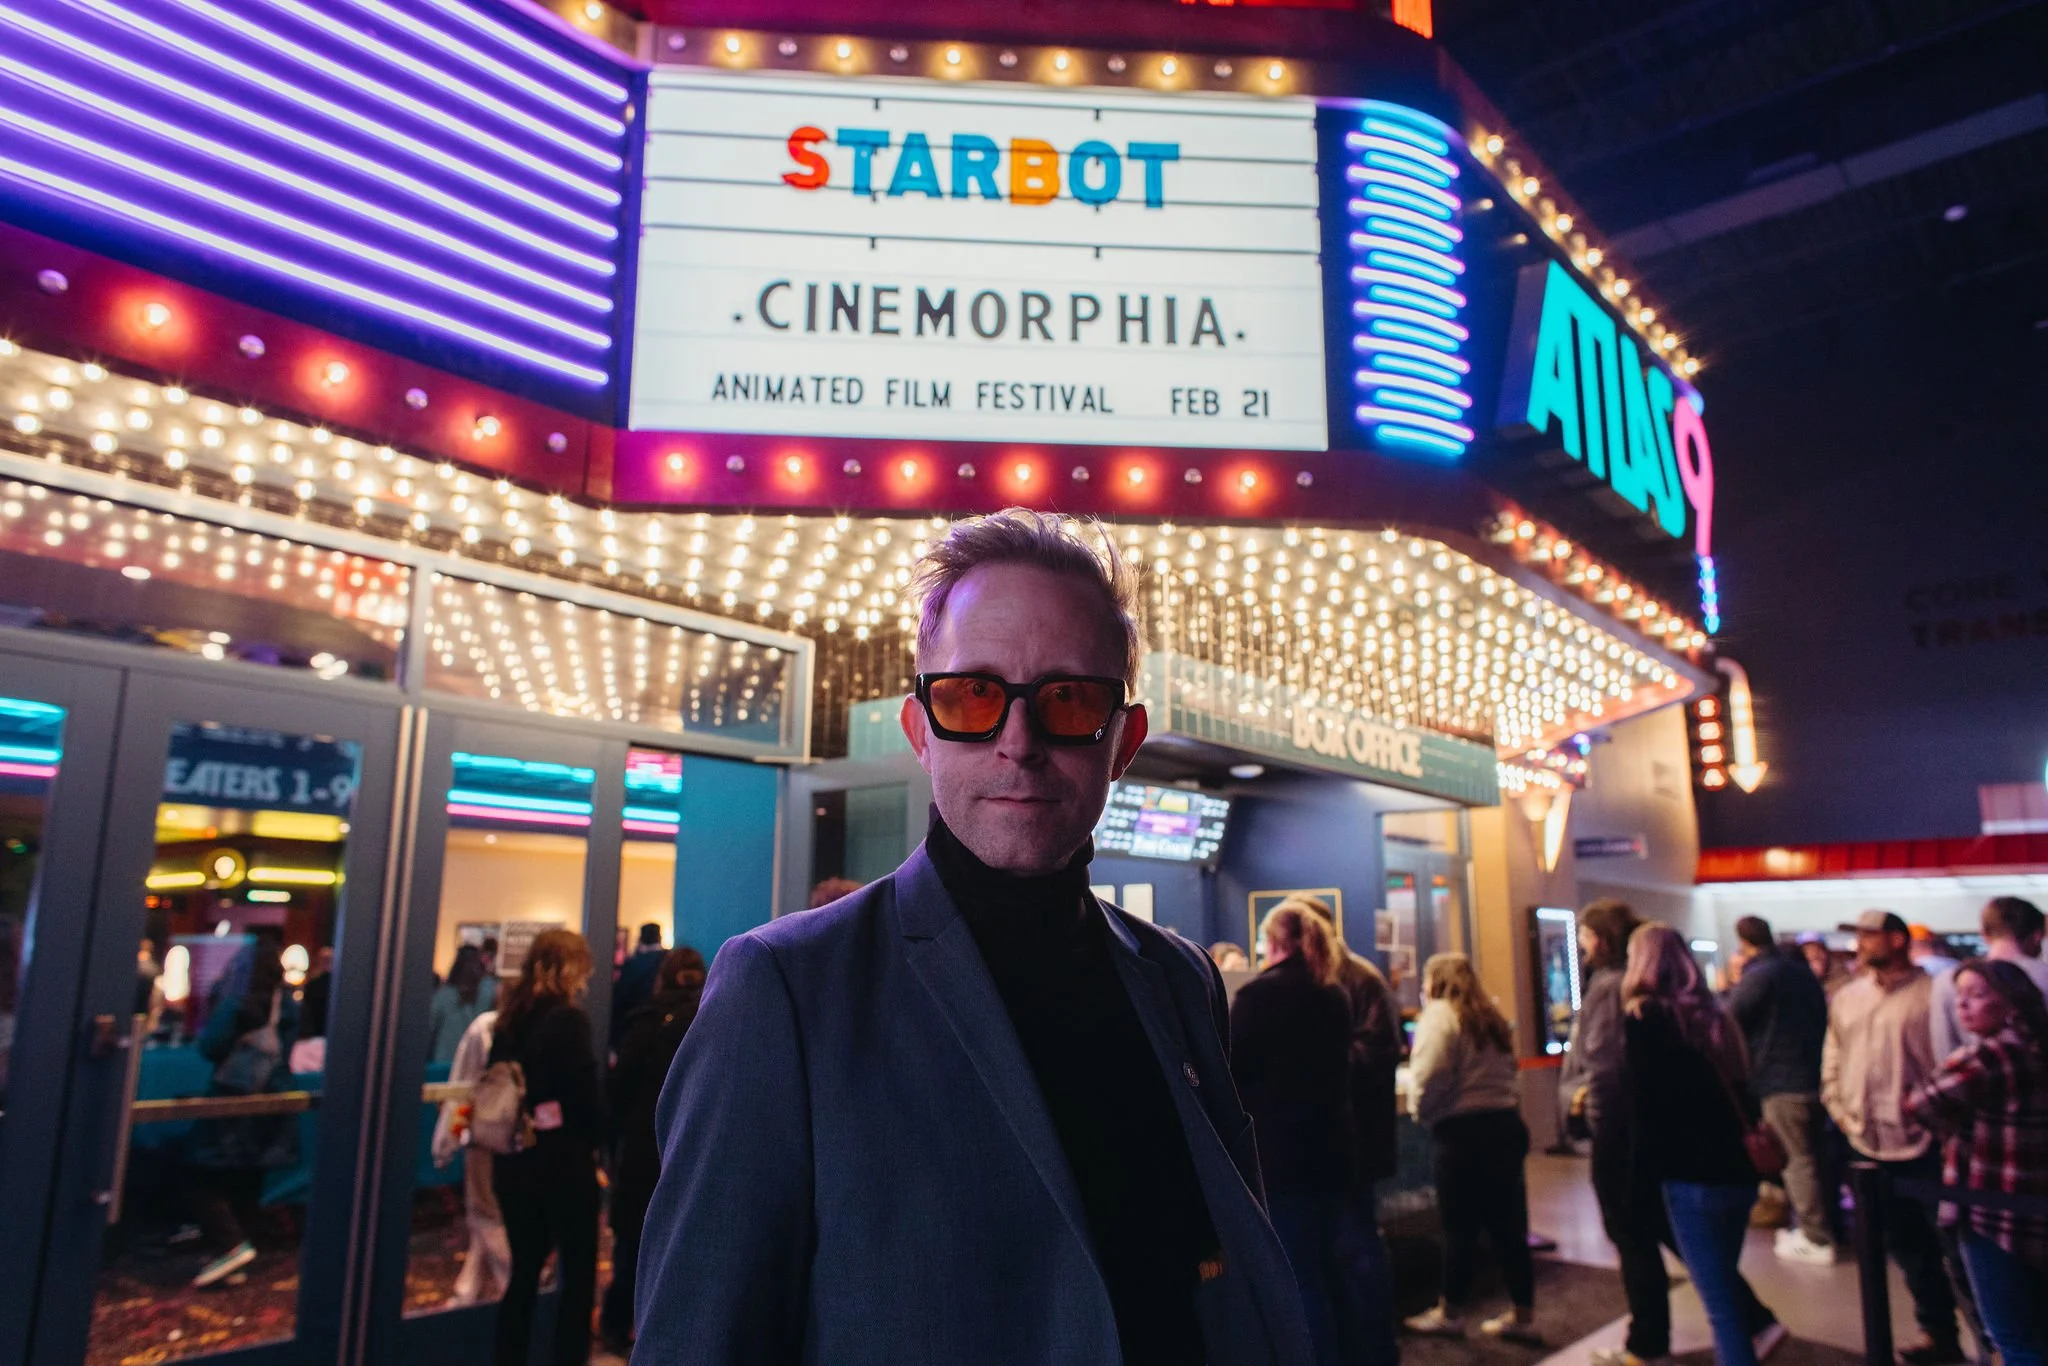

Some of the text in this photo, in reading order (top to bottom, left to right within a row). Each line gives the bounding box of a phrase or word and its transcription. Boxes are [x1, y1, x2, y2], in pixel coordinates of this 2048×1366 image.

[782, 126, 1180, 208] STARBOT
[712, 372, 1269, 417] ANIMATED FILM FESTIVAL FEB 21
[1293, 701, 1423, 778] BOX OFFICE
